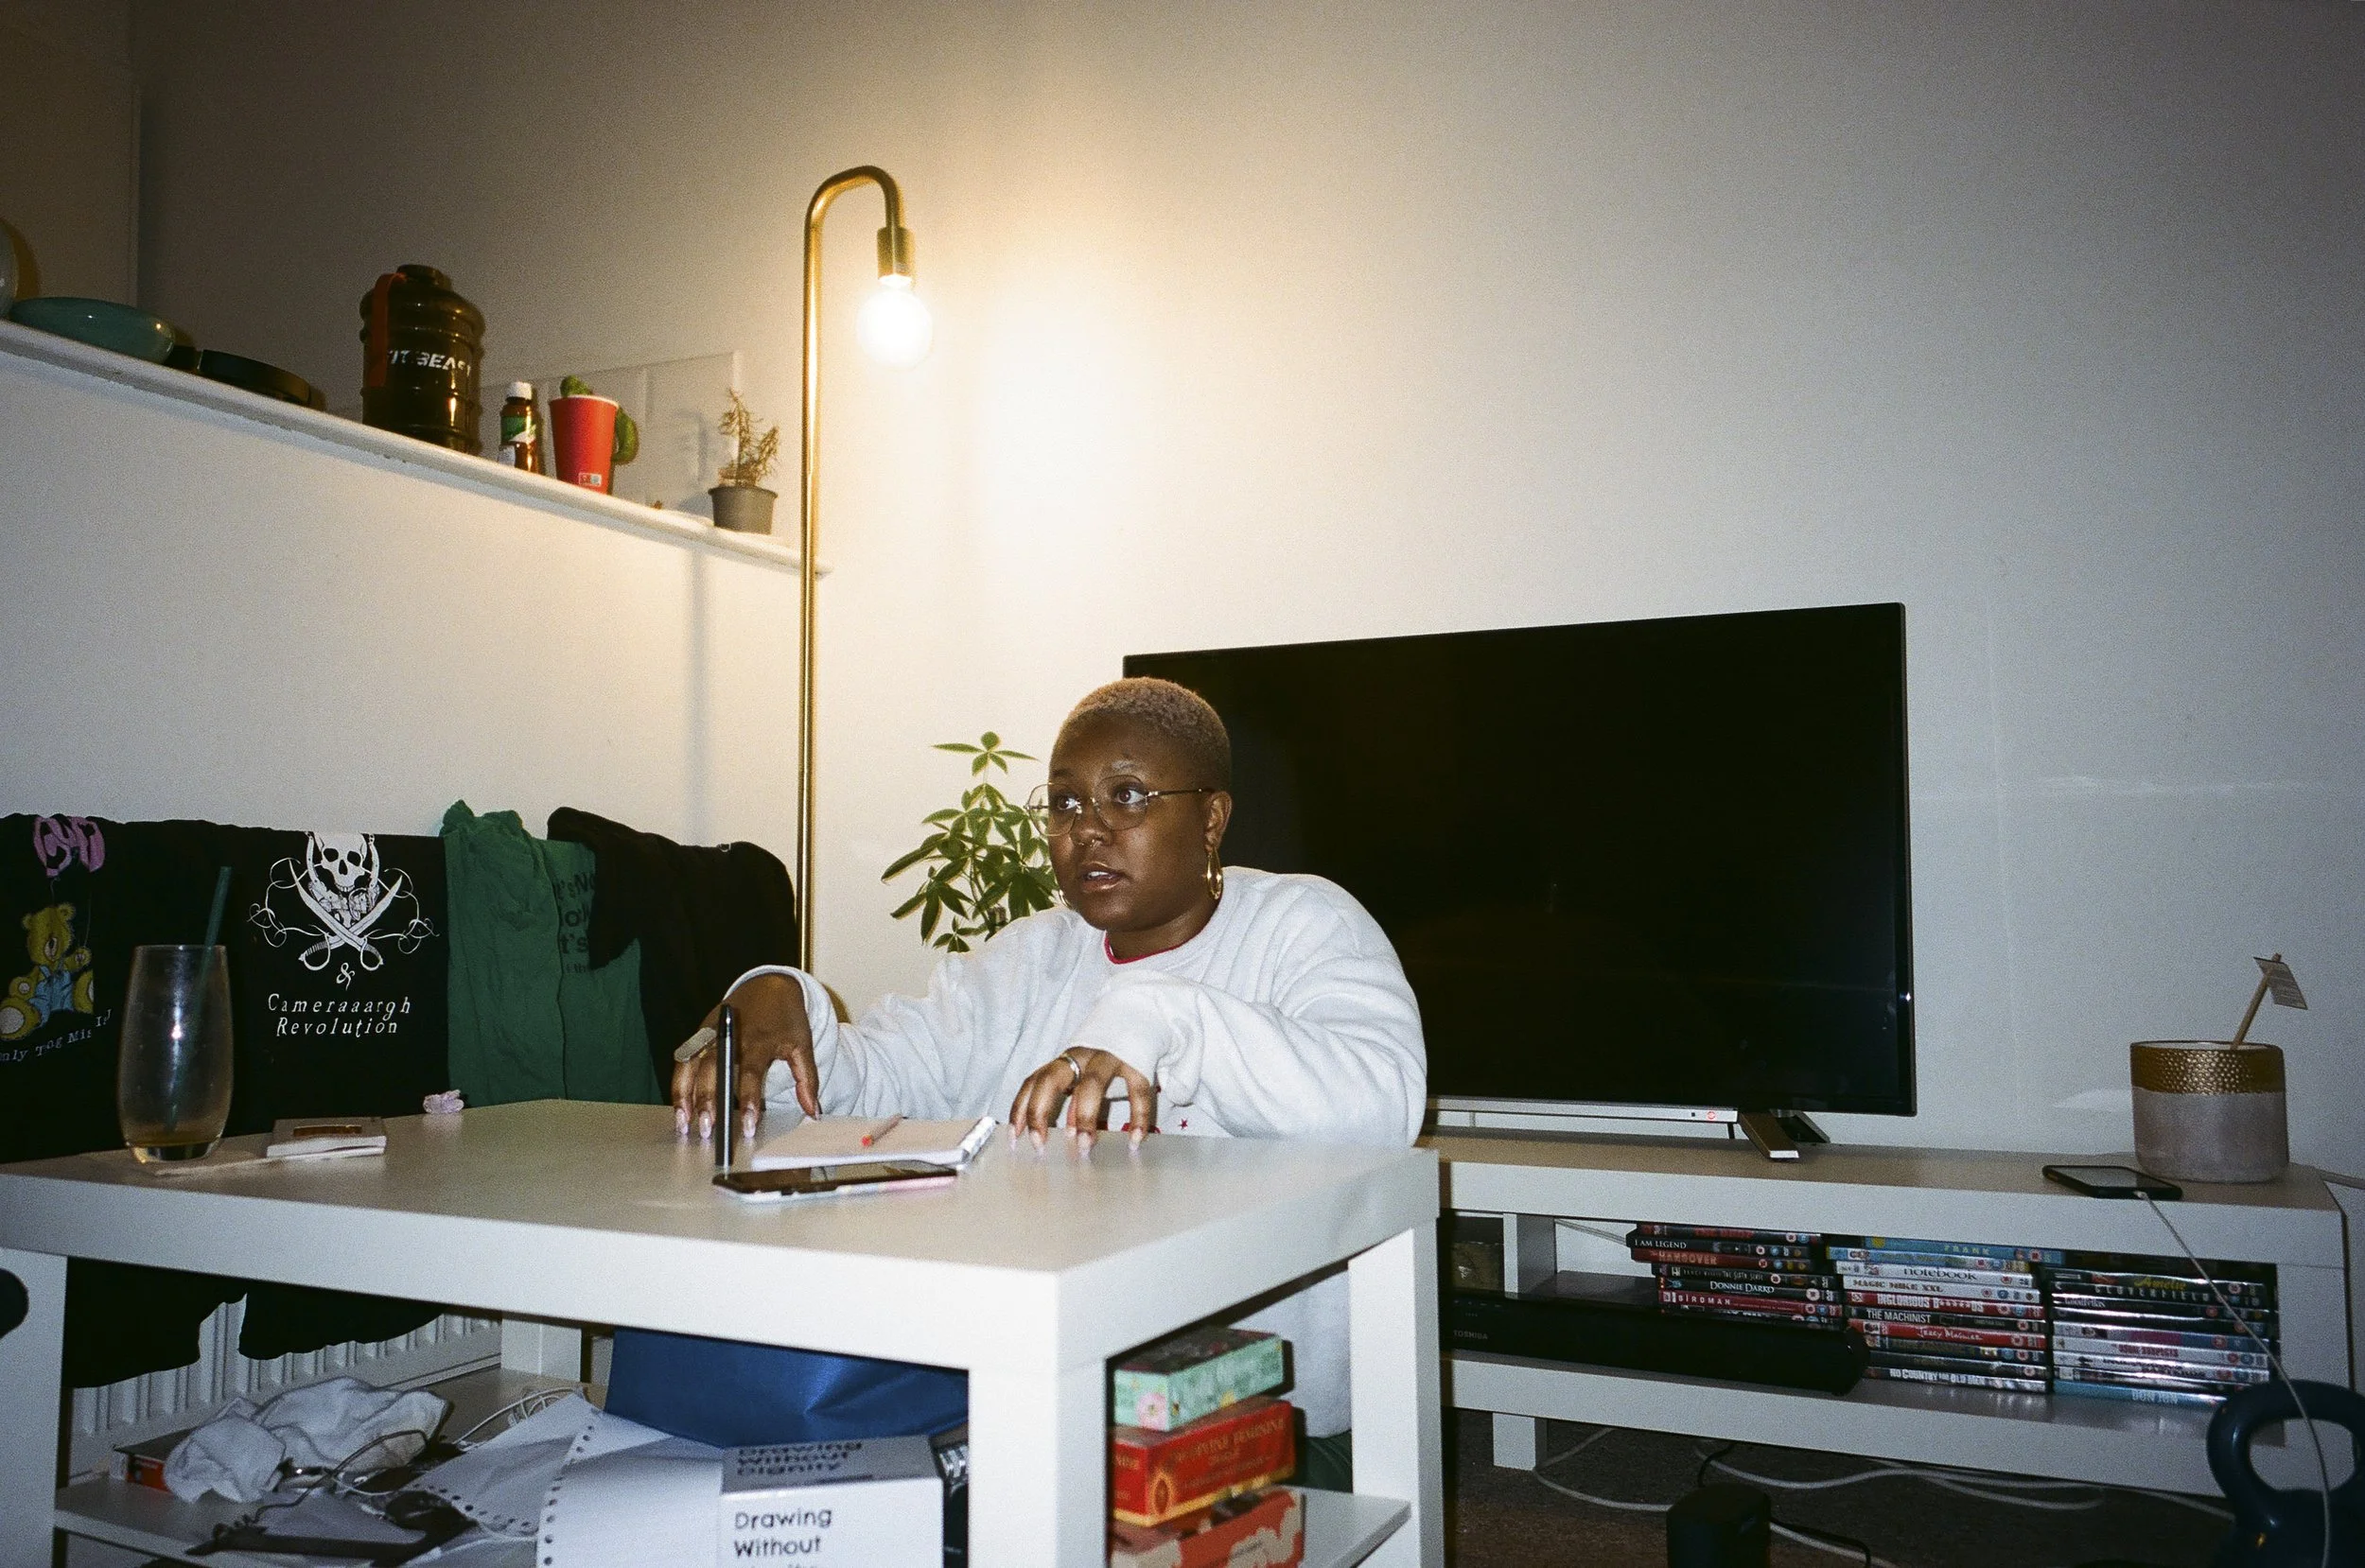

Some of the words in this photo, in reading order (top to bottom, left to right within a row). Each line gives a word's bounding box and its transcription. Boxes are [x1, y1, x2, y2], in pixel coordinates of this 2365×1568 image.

[388, 349, 411, 365] IT
[336, 962, 356, 991] &
[268, 993, 412, 1021] Cameraaargh
[276, 1017, 397, 1038] Revolution
[0, 1049, 28, 1062] nly
[1655, 1241, 1688, 1249] LEGEND
[1903, 1266, 1977, 1281] notebook
[1709, 1281, 1744, 1292] DONNIE
[1744, 1283, 1775, 1294] DARKO
[1866, 1309, 1883, 1320] THE
[1883, 1311, 1932, 1324] MACHINIST
[1452, 1329, 1489, 1341] TOSHIBA
[1901, 1368, 1938, 1381] COUNTRY
[734, 1508, 832, 1530] Drawing
[733, 1536, 821, 1558] Without
